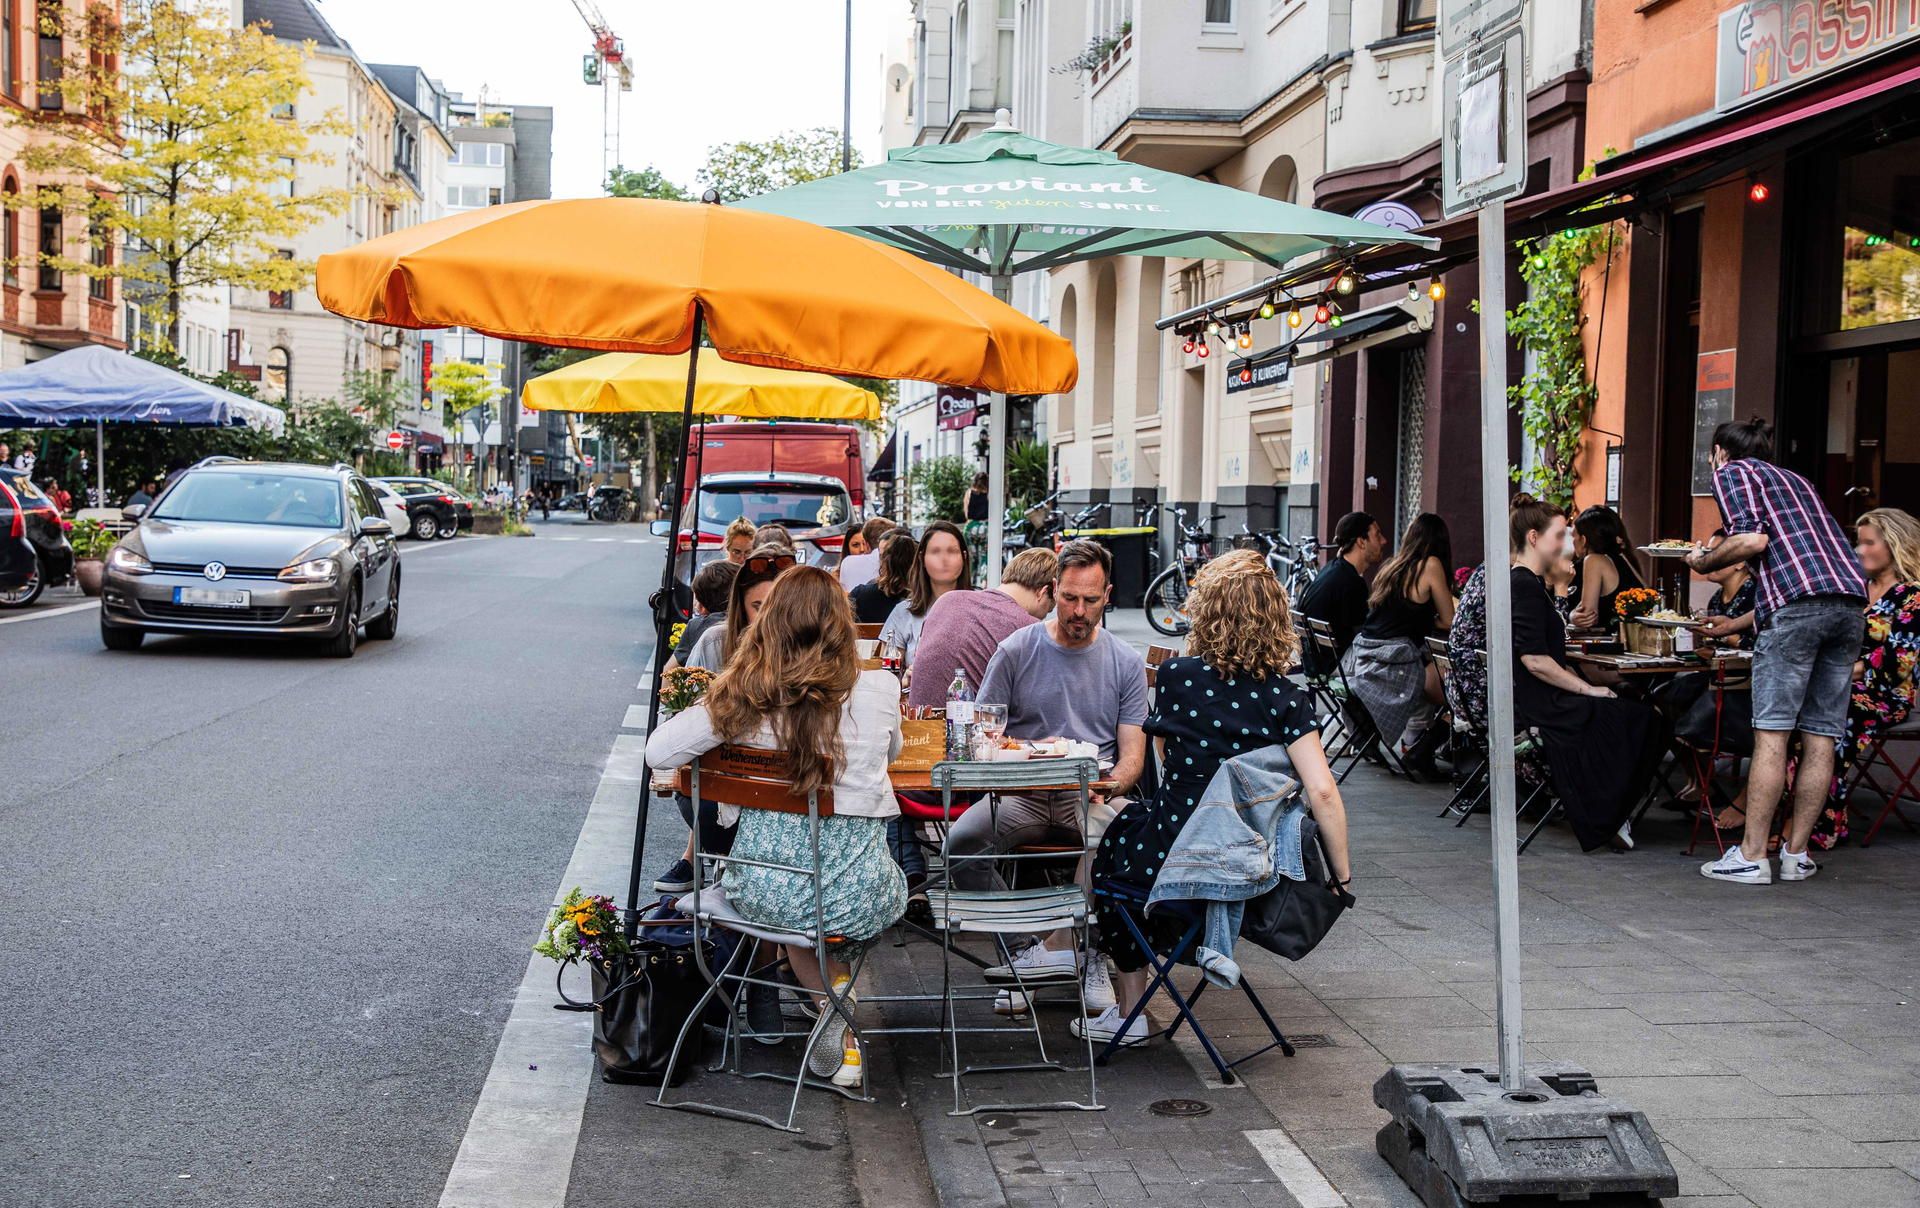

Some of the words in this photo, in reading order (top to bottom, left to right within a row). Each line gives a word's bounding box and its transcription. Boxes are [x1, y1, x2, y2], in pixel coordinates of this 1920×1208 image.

[875, 177, 1157, 197] Proviant
[876, 200, 928, 209] VON
[936, 199, 983, 208] DER
[987, 198, 1073, 210] guten
[135, 400, 172, 418] Sion
[903, 732, 930, 747] viant
